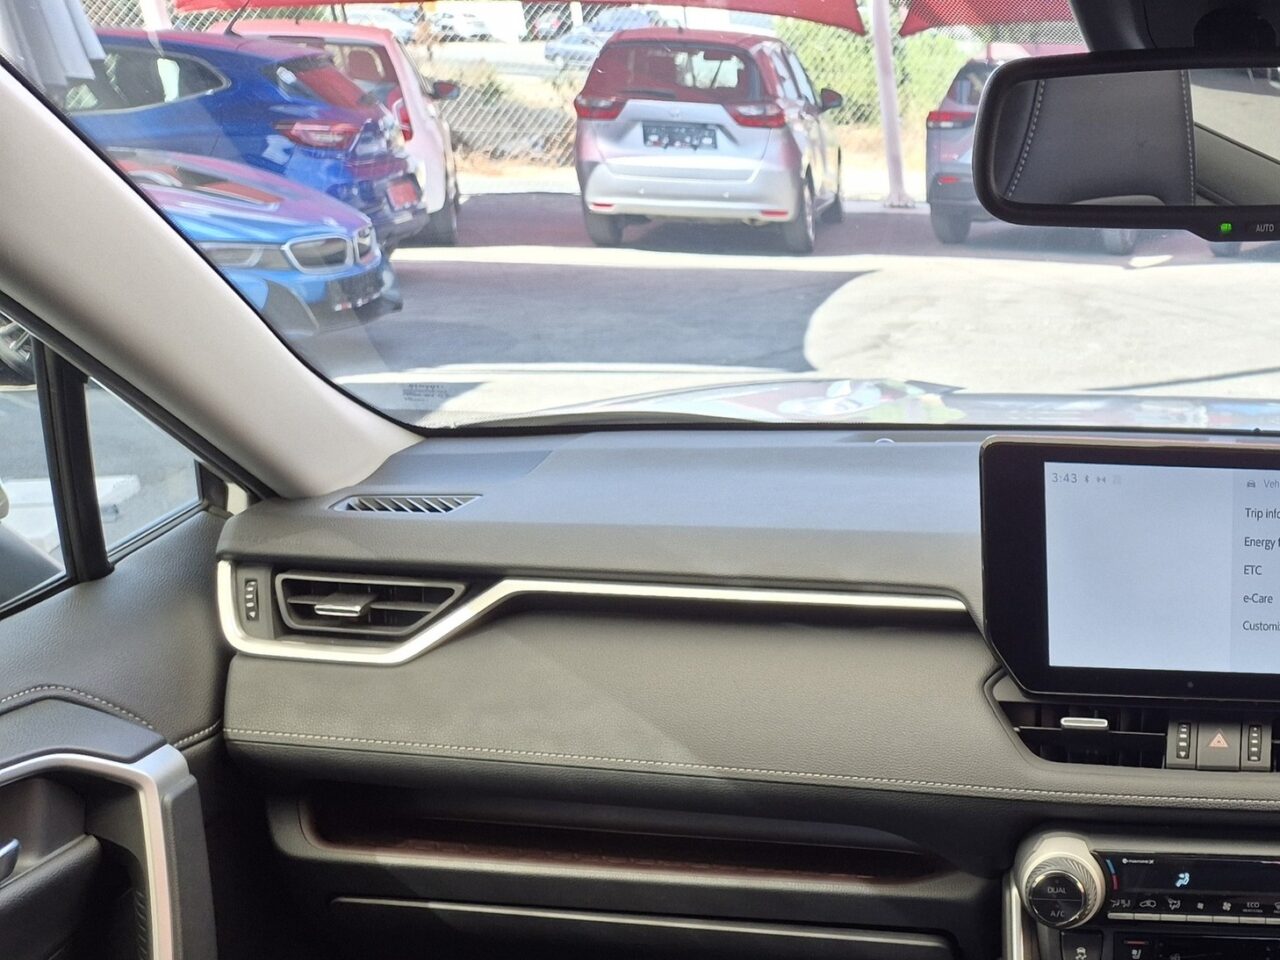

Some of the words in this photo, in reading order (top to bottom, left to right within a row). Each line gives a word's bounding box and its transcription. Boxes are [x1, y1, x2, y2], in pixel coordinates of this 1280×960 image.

[1255, 223, 1275, 232] AUTO
[1051, 472, 1078, 483] 3:43
[1245, 507, 1264, 521] Trip
[1244, 536, 1276, 551] Energy
[1243, 565, 1263, 576] ETC
[1243, 593, 1274, 604] e-Care
[1246, 901, 1260, 909] ECO
